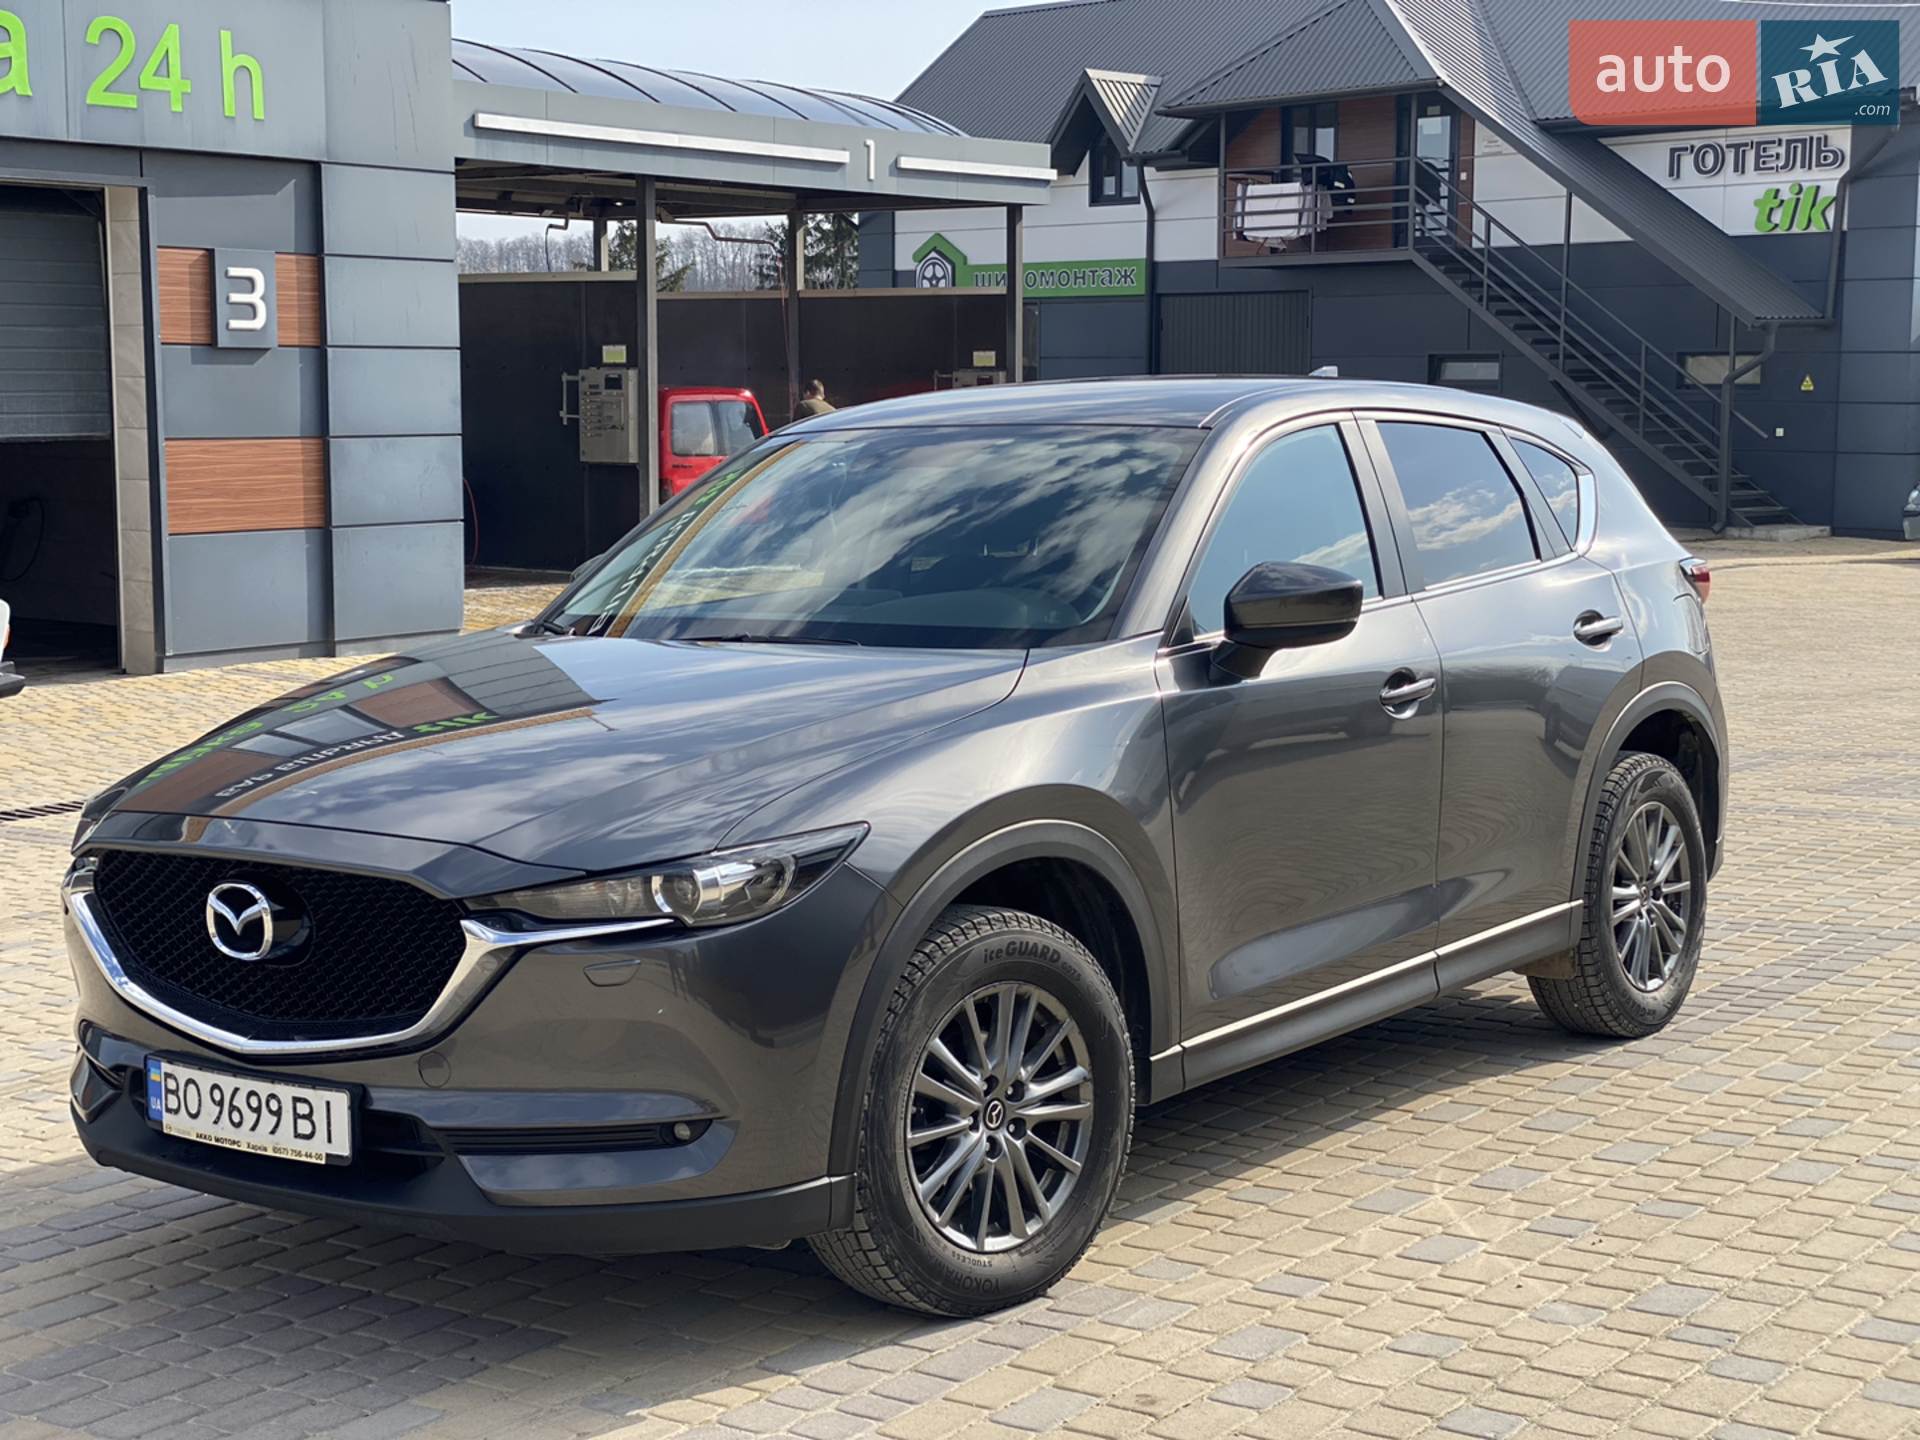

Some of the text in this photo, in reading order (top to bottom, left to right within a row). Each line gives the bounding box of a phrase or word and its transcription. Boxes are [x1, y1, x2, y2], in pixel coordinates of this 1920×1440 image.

[85, 15, 192, 112] 24
[219, 29, 265, 120] h
[863, 138, 876, 182] 1
[1668, 134, 1845, 180] ГОТЕЛЬ
[1754, 182, 1837, 232] tik
[226, 265, 268, 331] 3
[973, 265, 1137, 289] шиомонтаж
[150, 1096, 162, 1113] UA
